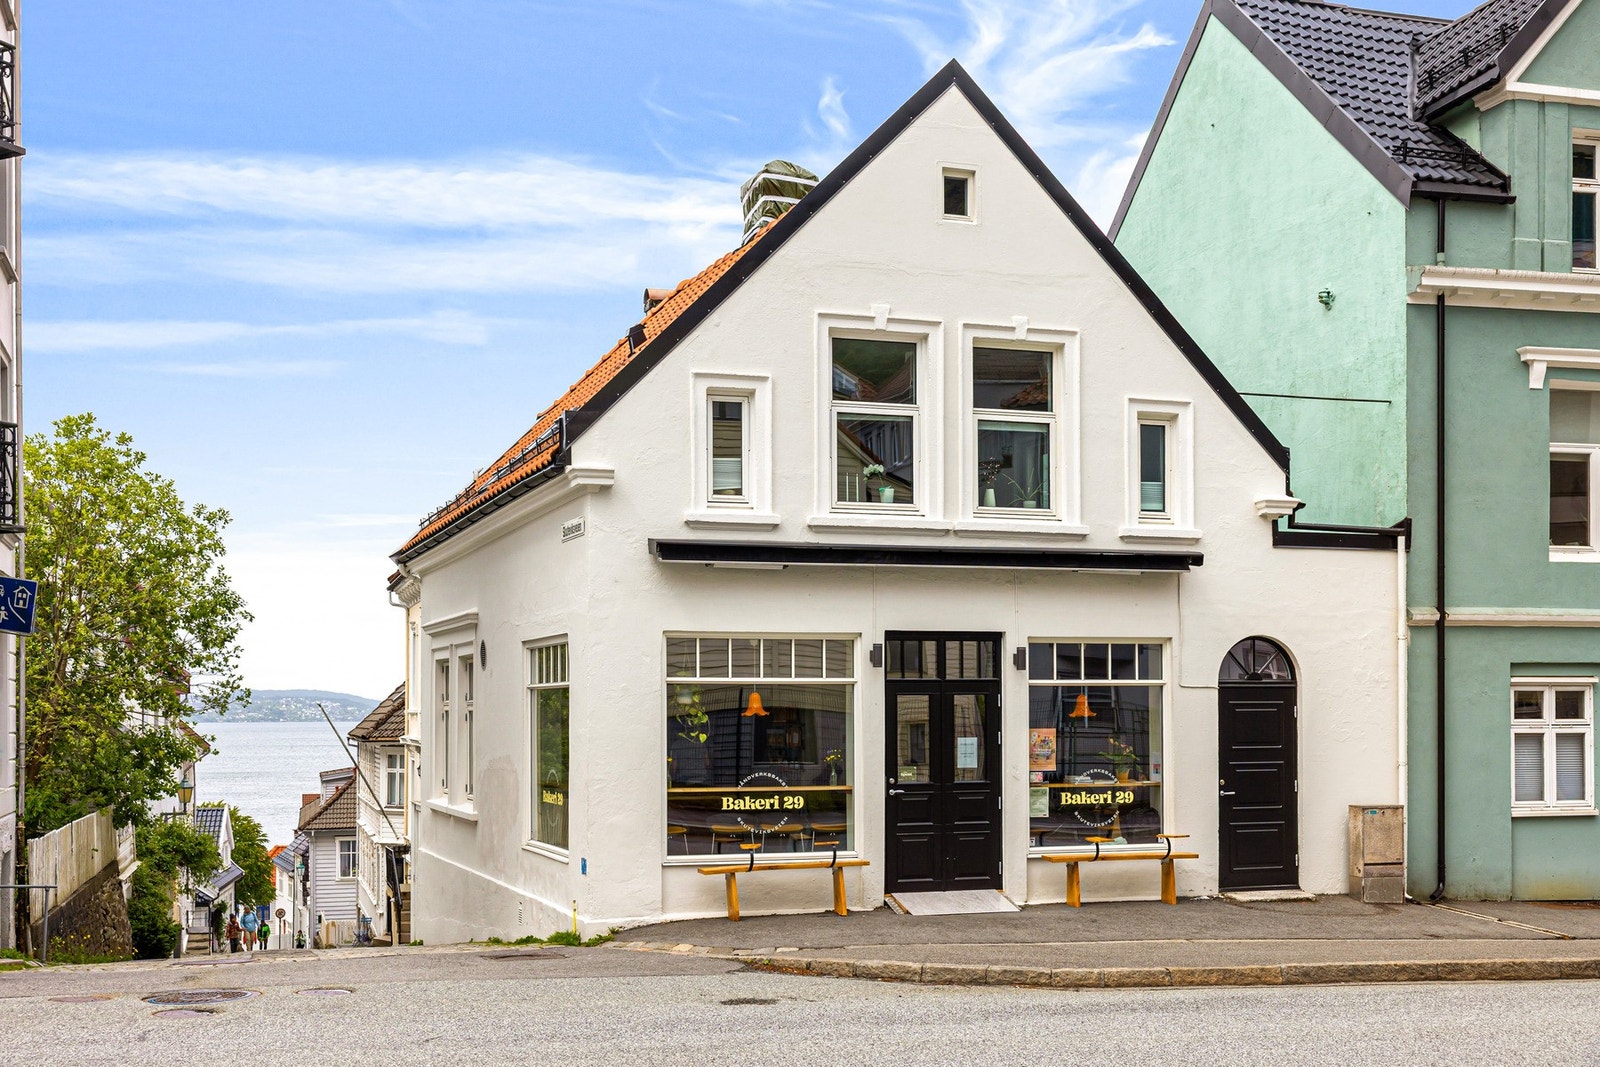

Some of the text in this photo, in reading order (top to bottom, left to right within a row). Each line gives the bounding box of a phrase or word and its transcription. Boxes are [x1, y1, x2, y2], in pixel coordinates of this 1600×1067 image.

[721, 795, 804, 810] Bakeri 29
[1060, 790, 1112, 805] Bakeri
[1115, 790, 1134, 804] 29
